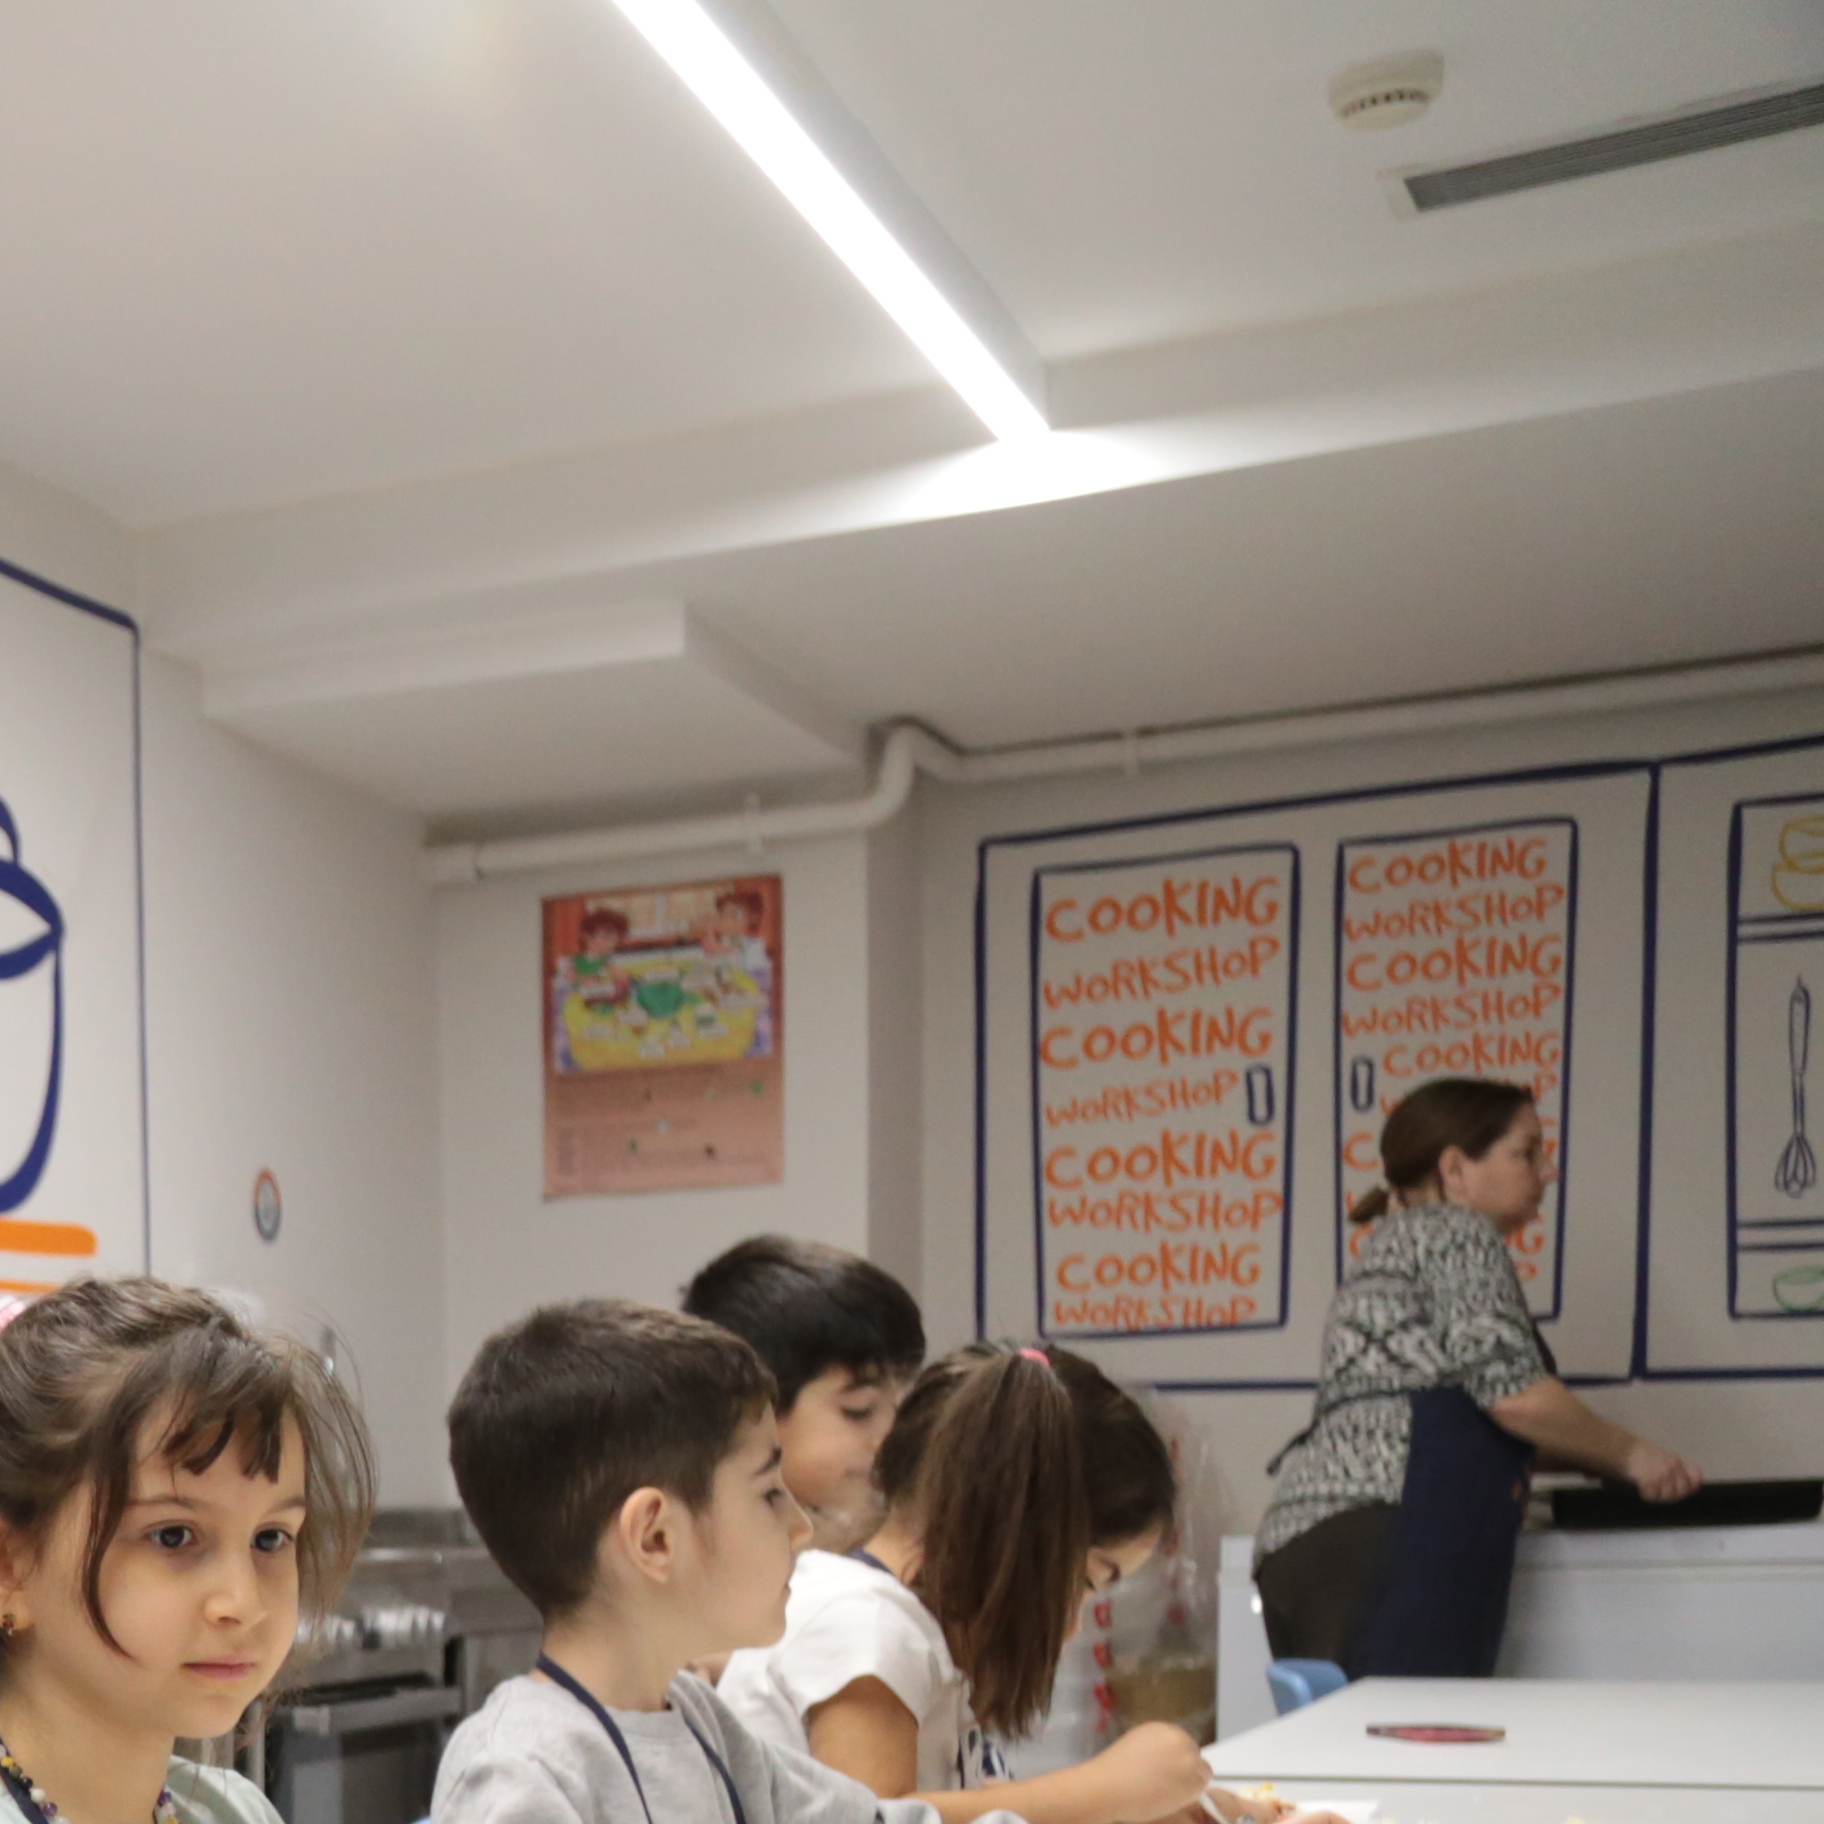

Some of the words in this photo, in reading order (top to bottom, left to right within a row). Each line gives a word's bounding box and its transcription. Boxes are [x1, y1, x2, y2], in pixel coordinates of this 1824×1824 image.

[1348, 836, 1548, 894] COOKING
[1045, 873, 1280, 943] COOKING
[1342, 883, 1565, 943] WORKSHOP
[1043, 935, 1282, 1010] WORKSHOP
[1346, 933, 1564, 992] COOKING
[1039, 1004, 1274, 1070] COOKING
[1341, 982, 1564, 1041] WORKSHOP
[1383, 1031, 1561, 1078] COOKING
[1045, 1068, 1240, 1128] WORKSHOP
[1044, 1127, 1277, 1191] COOKING
[1048, 1188, 1284, 1234] WORKSHOP
[1056, 1240, 1262, 1294] COOKING
[1054, 1292, 1259, 1334] WORKSHOP
